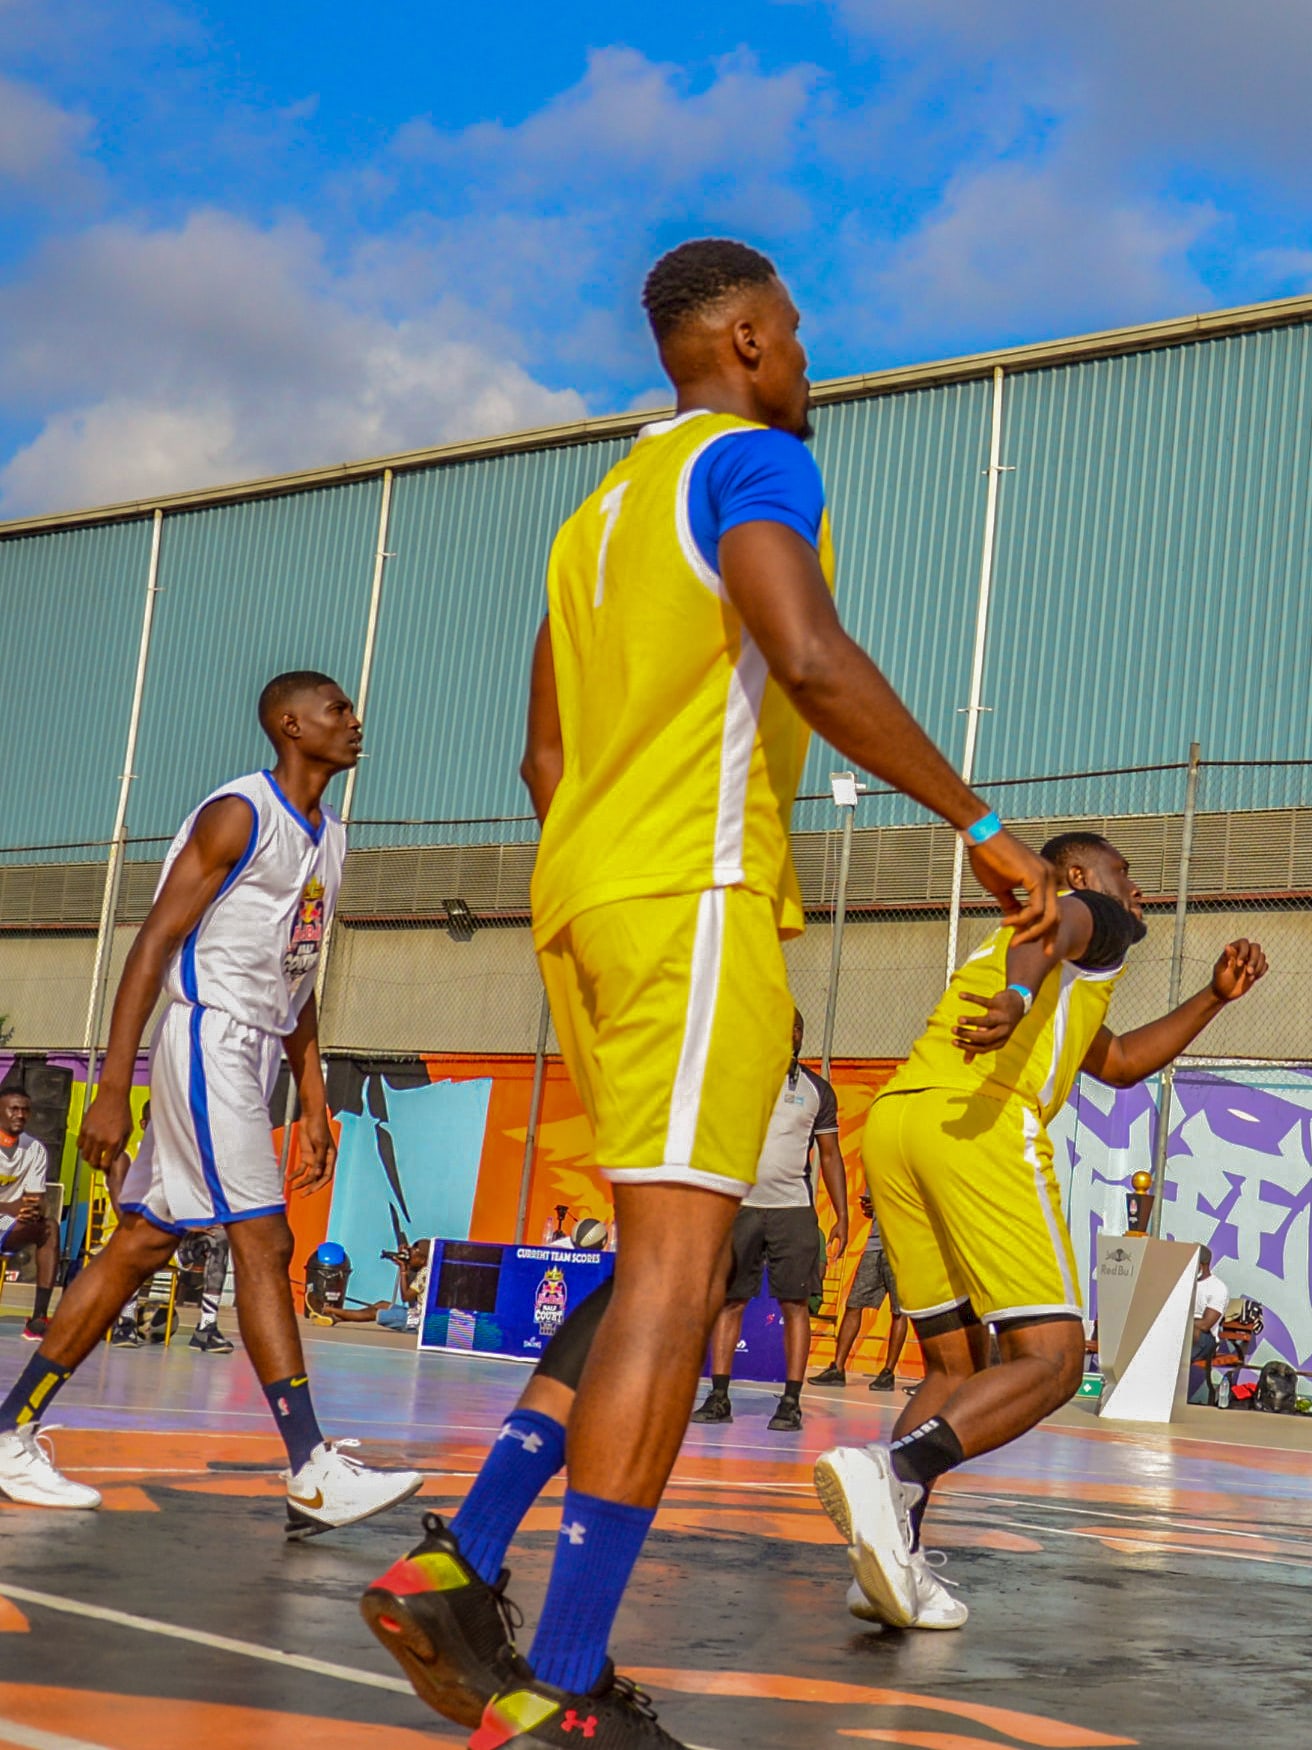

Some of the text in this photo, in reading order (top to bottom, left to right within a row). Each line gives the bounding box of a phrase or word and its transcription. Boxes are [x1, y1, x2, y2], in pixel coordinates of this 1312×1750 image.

[593, 480, 631, 607] 1
[517, 1248, 600, 1263] CURRENT TEAM SCORES
[1101, 1264, 1117, 1276] Red
[535, 1309, 562, 1323] COURT
